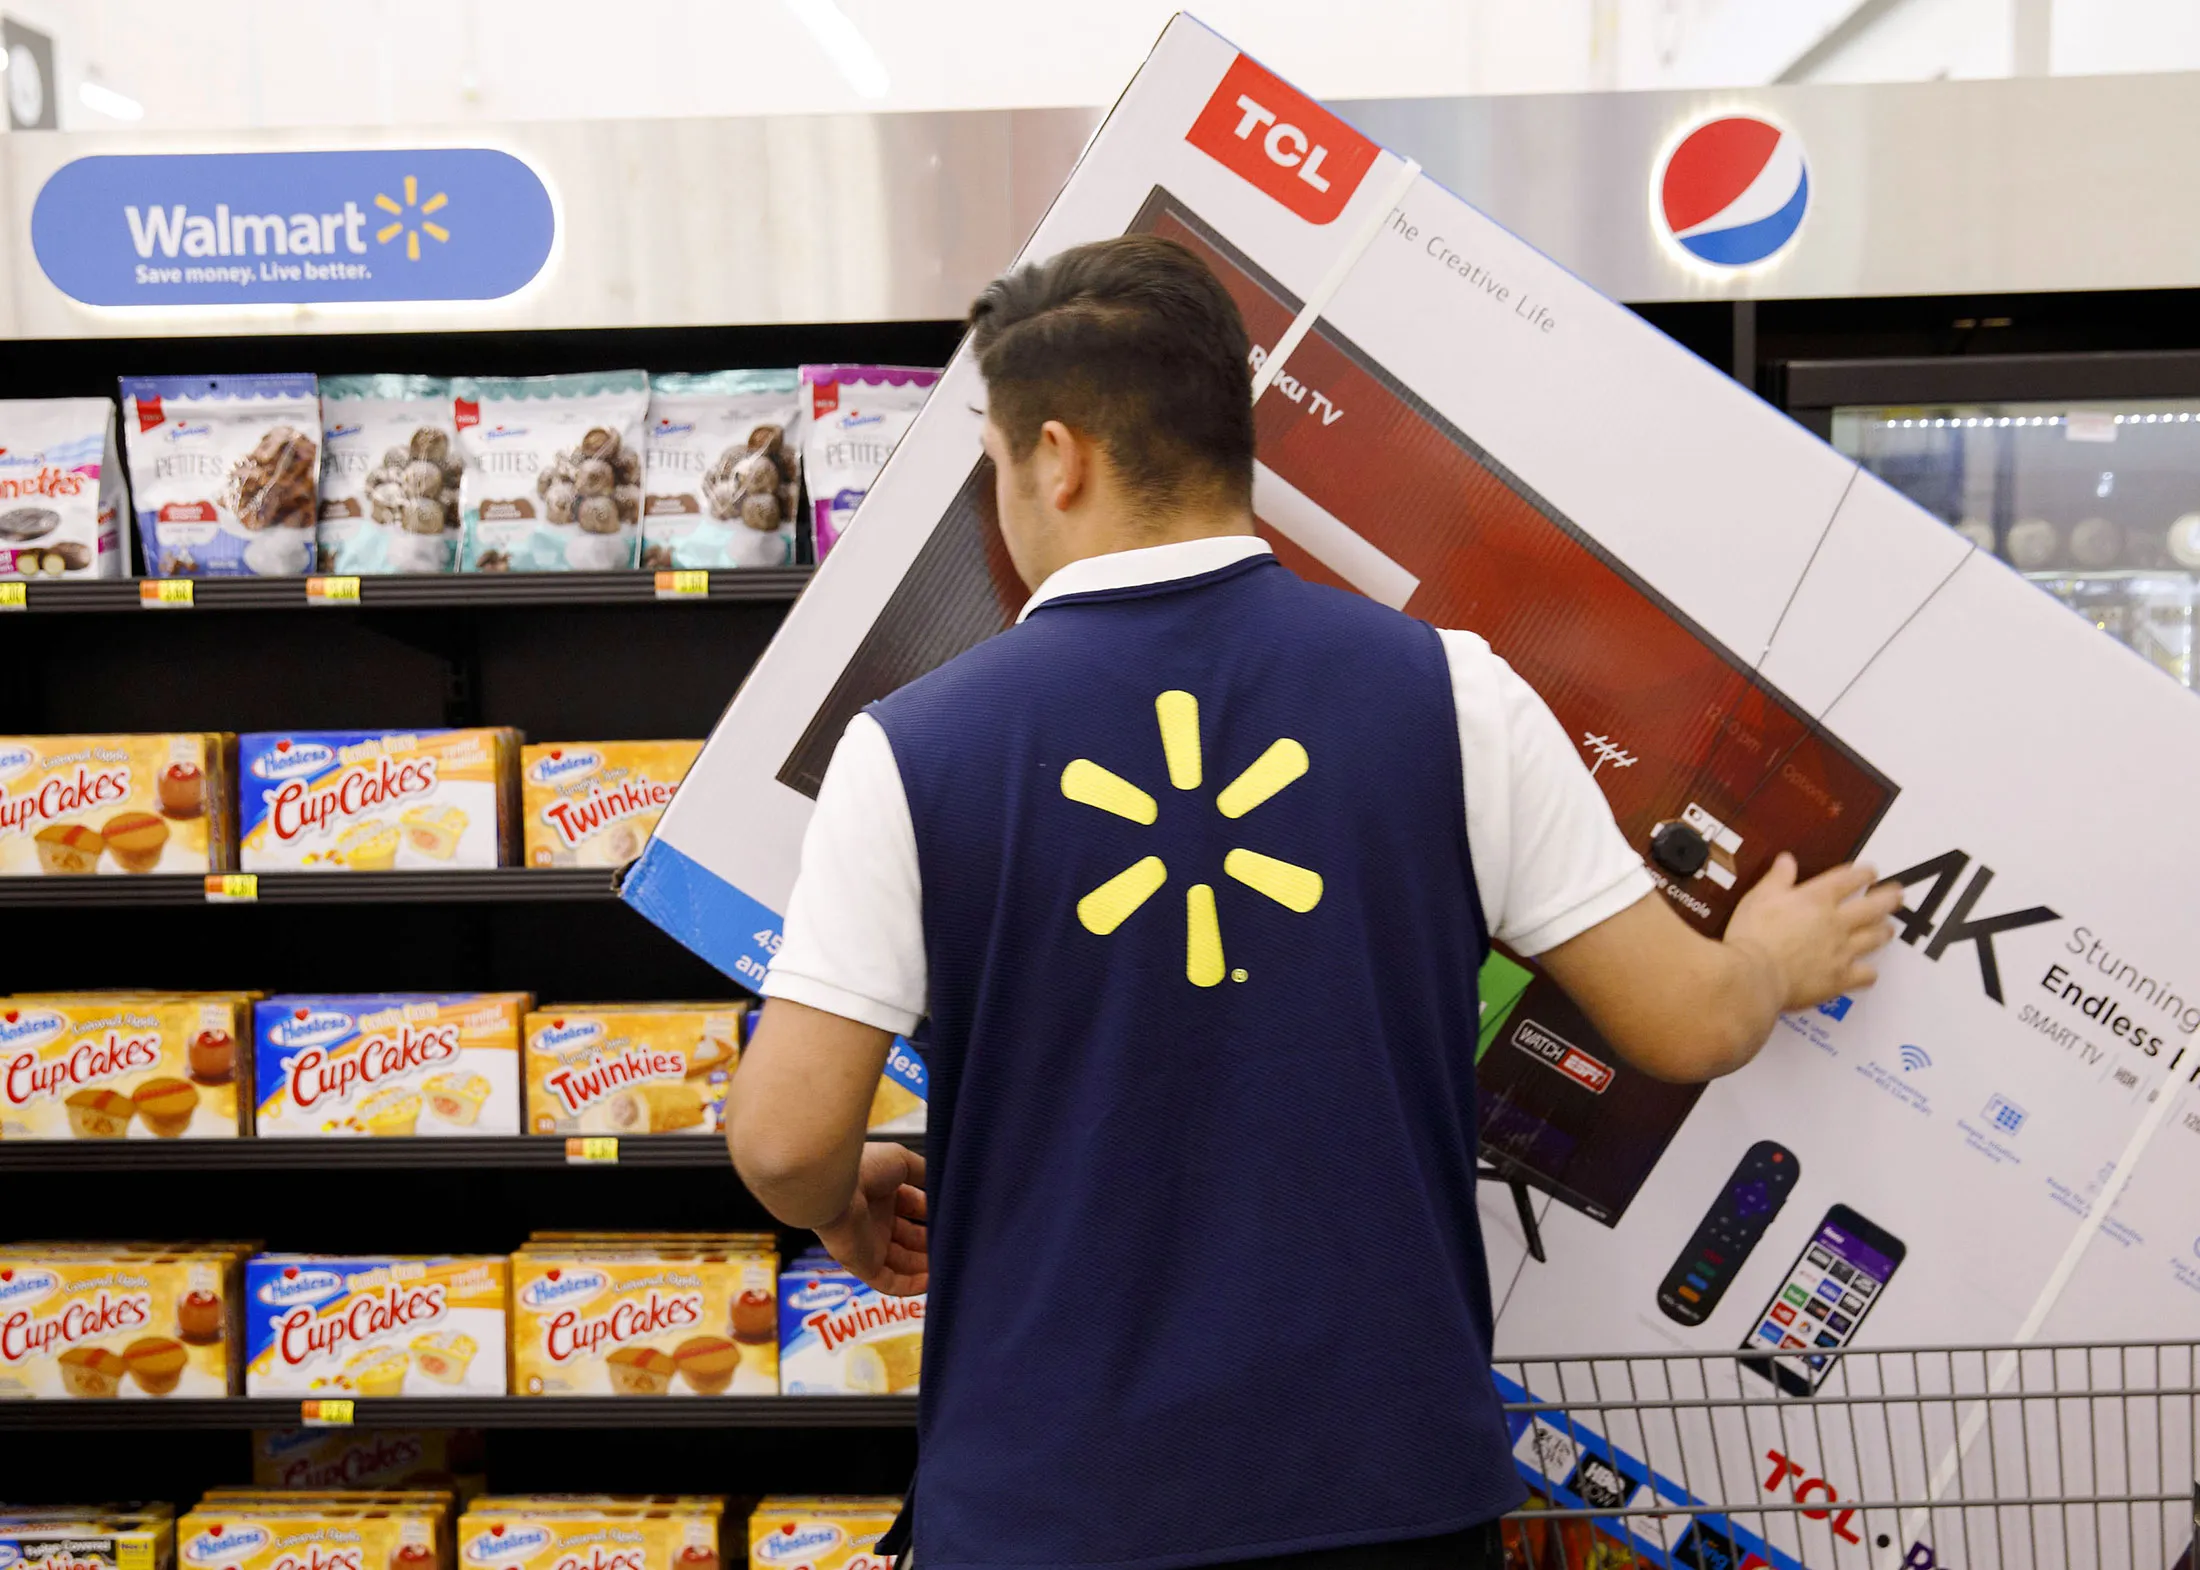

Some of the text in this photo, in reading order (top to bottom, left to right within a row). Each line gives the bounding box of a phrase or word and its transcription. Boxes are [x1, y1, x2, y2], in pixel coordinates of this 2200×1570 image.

[1233, 93, 1331, 194] TCL
[123, 201, 368, 258] Walmart
[135, 259, 373, 287] Save money. Live better.
[1426, 236, 1510, 303] Creative
[1515, 295, 1556, 334] Life
[1247, 344, 1344, 426] Rku TV
[264, 747, 328, 777] Hostess
[539, 755, 594, 780] Hostess
[0, 769, 126, 832] upCakes
[271, 759, 433, 841] CupCakes
[1666, 884, 1711, 919] console
[1868, 848, 2064, 1007] 4K
[2040, 963, 2164, 1058] Endless
[2064, 925, 2200, 1035] Stunning
[281, 1014, 347, 1044] Hostess
[541, 1022, 596, 1049] Hostess
[1519, 1026, 1608, 1086] WATCH ESPN
[2017, 1003, 2081, 1051] SMART
[2079, 1041, 2104, 1066] TV
[6, 1035, 158, 1104] CupCakes
[288, 1027, 456, 1107] CupCakes
[550, 1048, 683, 1110] Twinkies
[271, 1275, 336, 1304] Hostess
[533, 1275, 600, 1305] Hostess
[1, 1293, 146, 1361] CupCakes
[280, 1287, 441, 1365] CupCakes
[546, 1292, 699, 1361] CupCakes
[807, 1297, 926, 1351] Twinkie
[195, 1530, 262, 1560] Hostess
[476, 1530, 543, 1561] Hostess
[768, 1528, 834, 1560] Hostess
